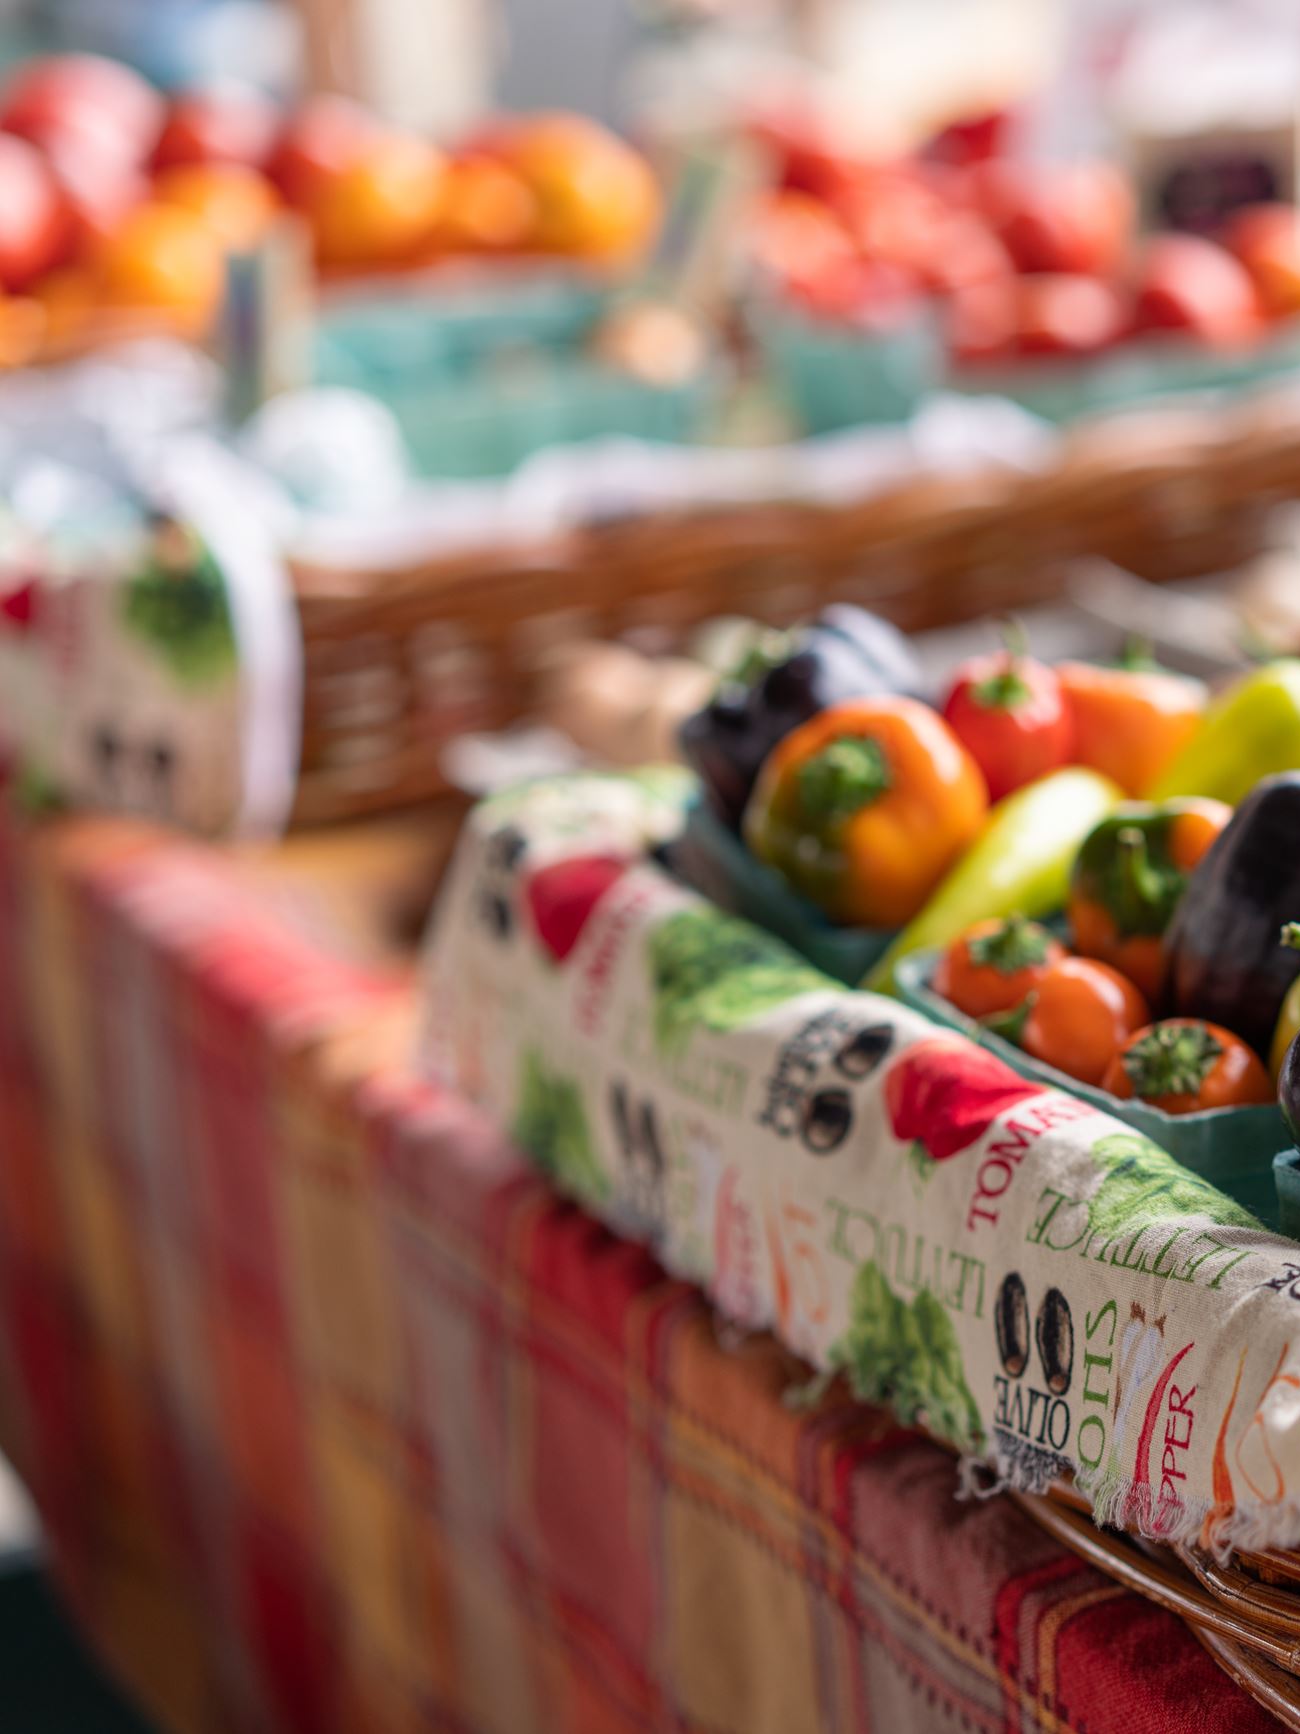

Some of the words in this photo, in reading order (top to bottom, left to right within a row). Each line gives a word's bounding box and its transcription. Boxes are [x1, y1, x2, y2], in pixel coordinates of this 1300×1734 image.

[1024, 1187, 1258, 1291] LETTUCE
[993, 1375, 1071, 1451] OLIVE
[1077, 1299, 1117, 1480] ONS
[1153, 1384, 1198, 1534] PPER
